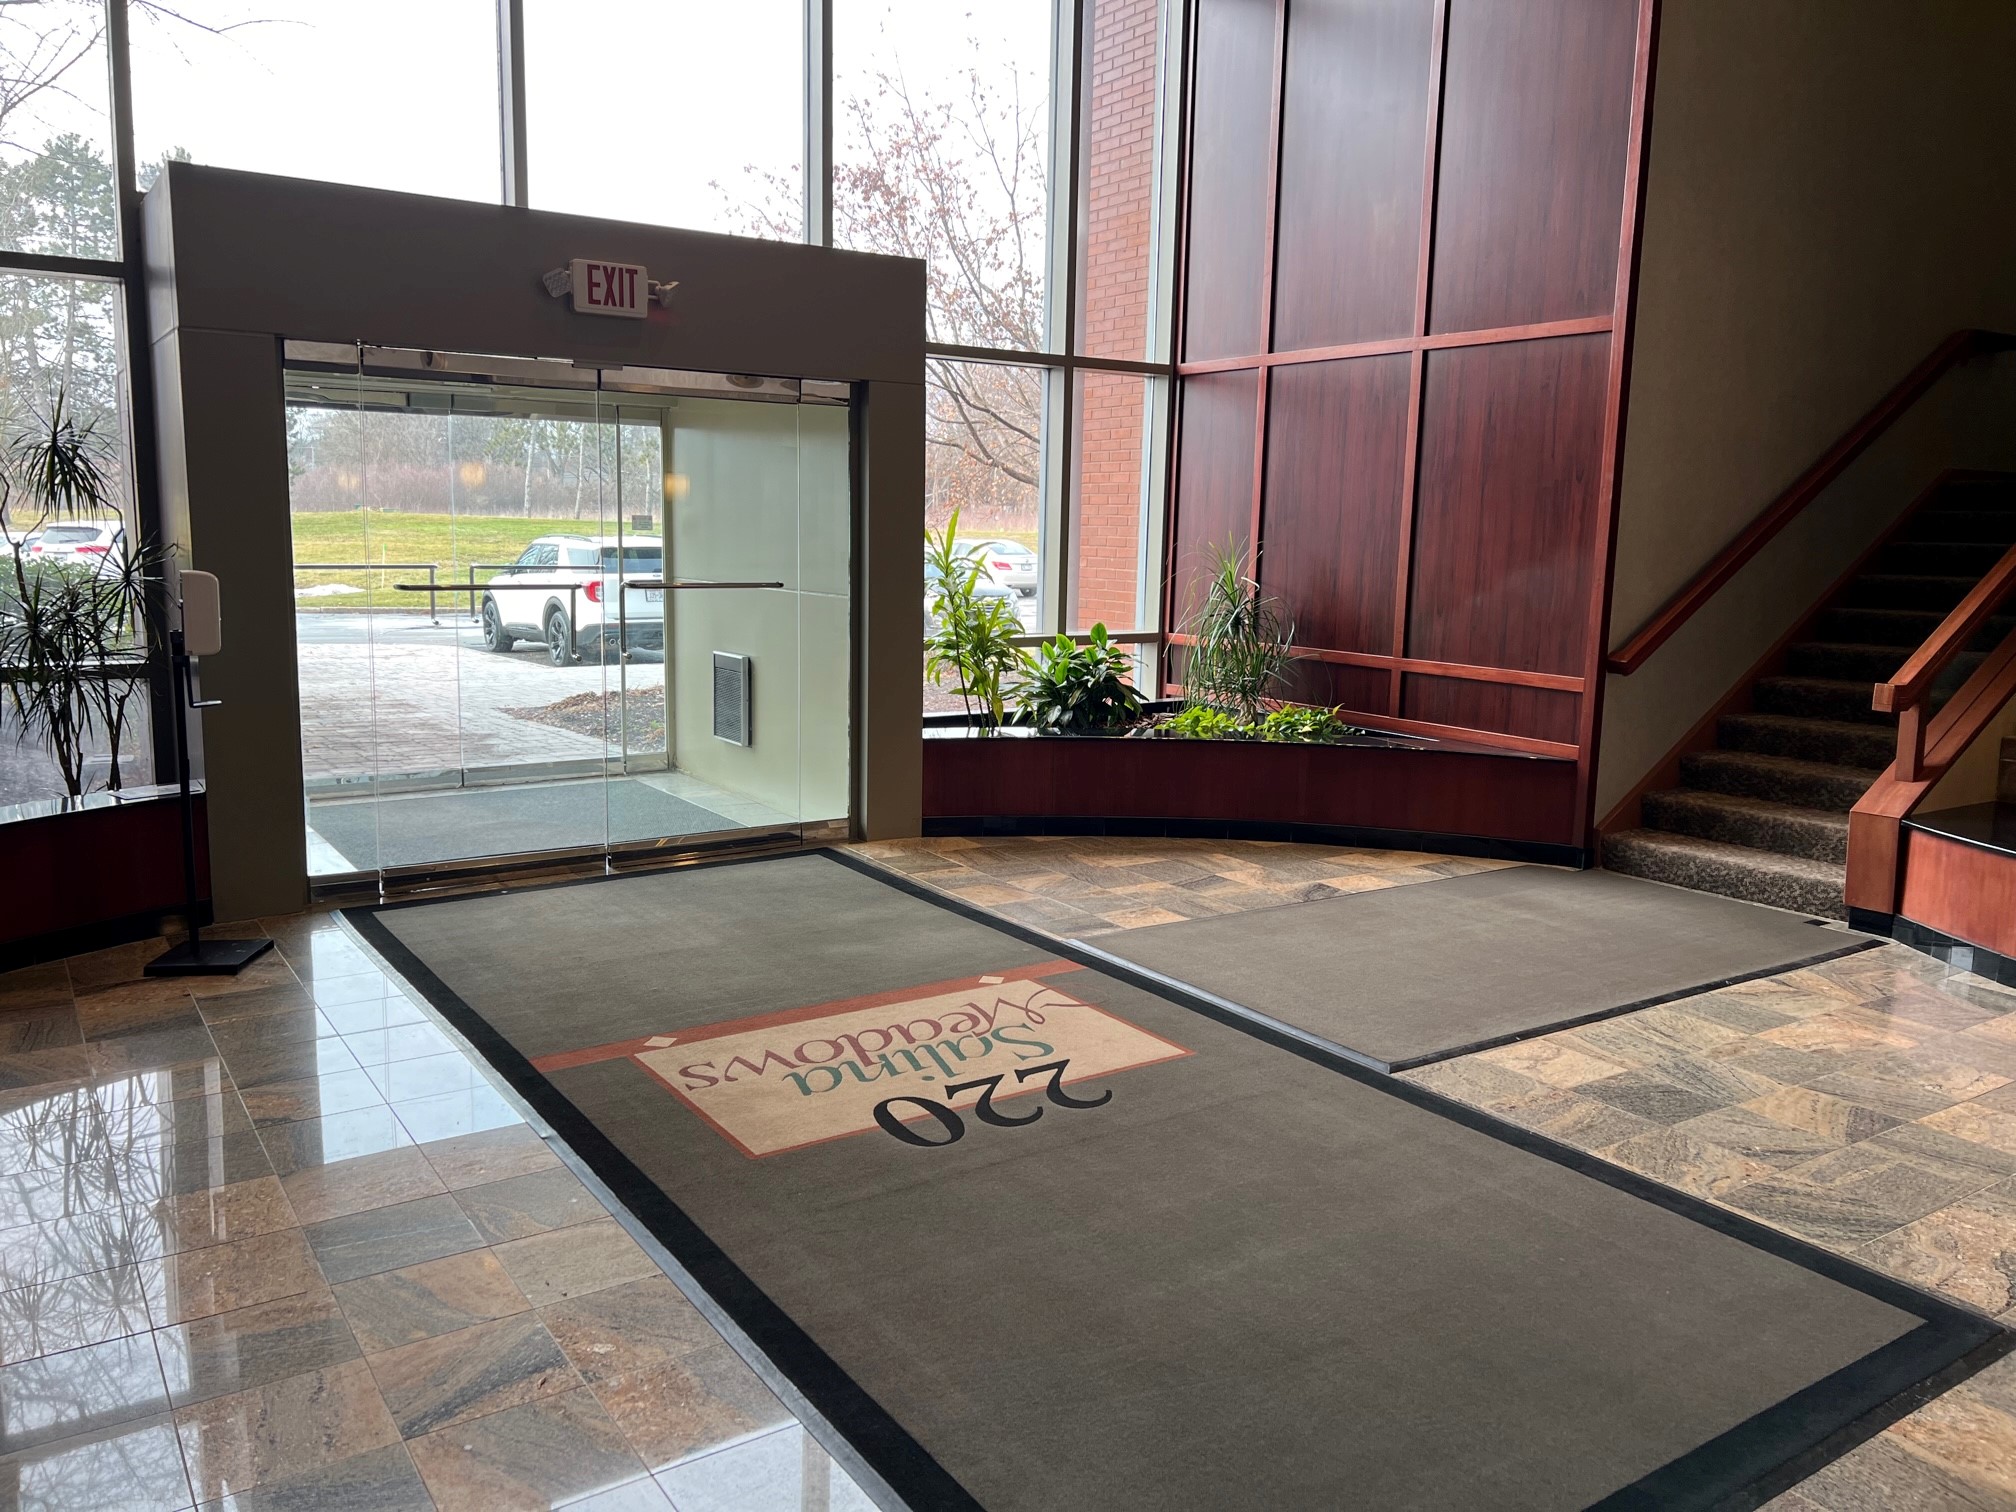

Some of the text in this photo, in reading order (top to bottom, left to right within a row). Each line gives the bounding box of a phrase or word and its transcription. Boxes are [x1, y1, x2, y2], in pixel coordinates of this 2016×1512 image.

[587, 264, 638, 309] EXIT
[678, 987, 1090, 1091] Meadows
[782, 1023, 1055, 1096] Salina
[873, 1058, 1113, 1147] 220
